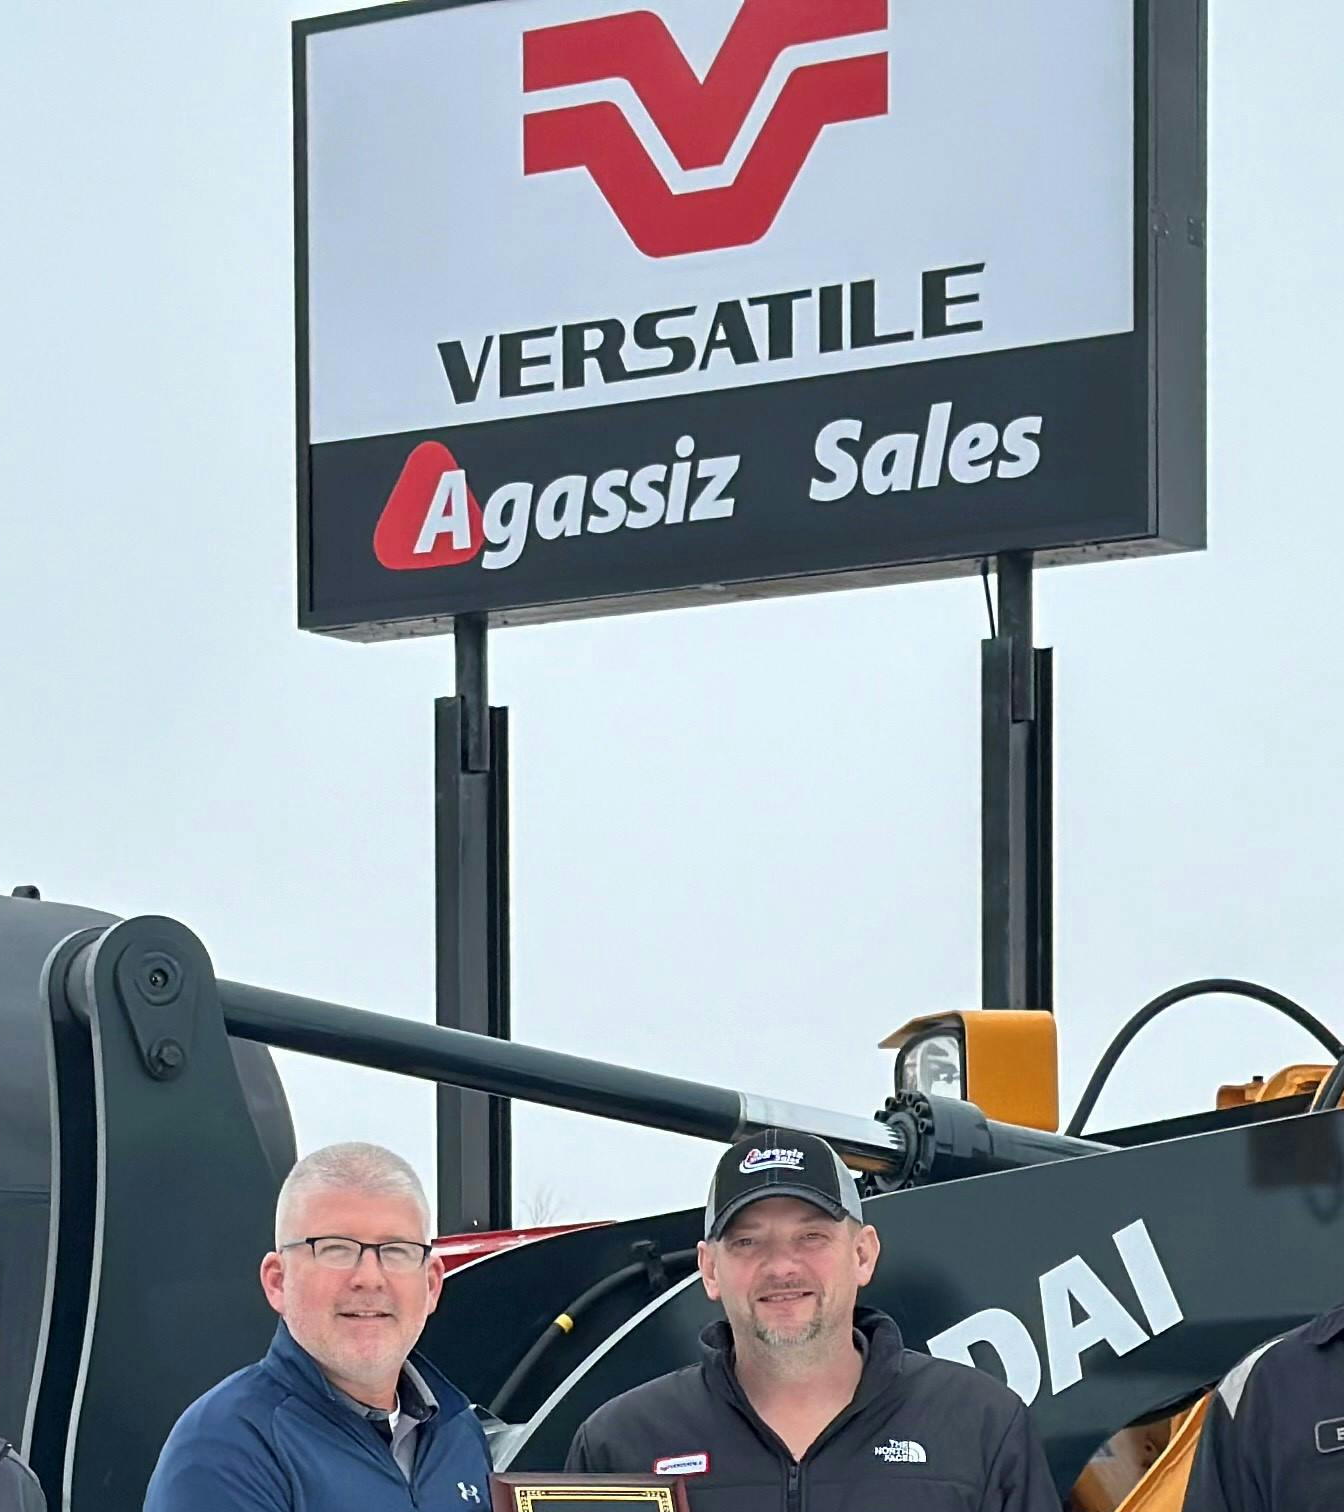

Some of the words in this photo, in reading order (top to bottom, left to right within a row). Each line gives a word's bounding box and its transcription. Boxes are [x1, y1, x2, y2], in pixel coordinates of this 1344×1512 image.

[437, 262, 986, 405] VERSATILE
[413, 434, 741, 570] Agassiz
[808, 402, 1043, 503] Sales
[927, 1218, 1184, 1407] DAI
[874, 1446, 909, 1455] NORTH
[884, 1454, 909, 1463] FACE
[889, 1439, 909, 1448] THE
